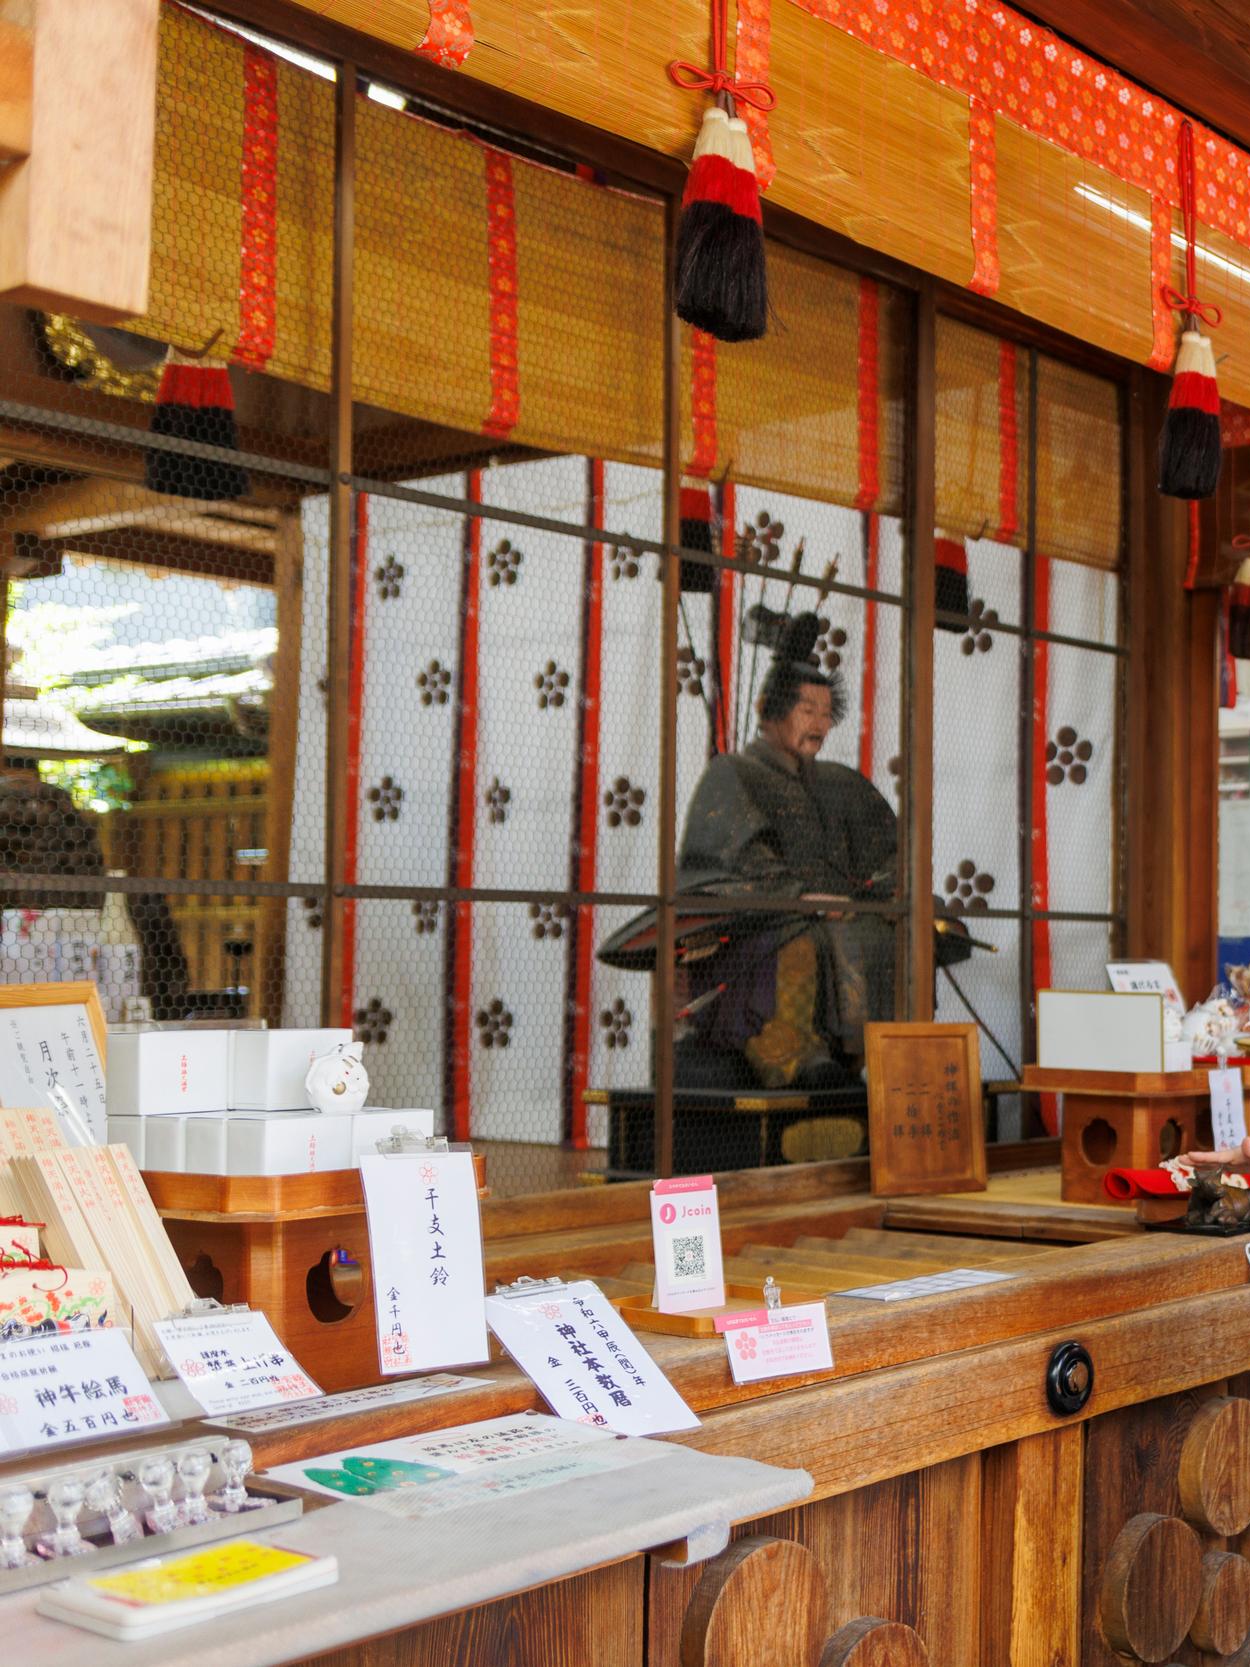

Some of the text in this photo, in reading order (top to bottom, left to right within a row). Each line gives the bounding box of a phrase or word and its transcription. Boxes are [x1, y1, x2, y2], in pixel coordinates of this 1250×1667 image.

[76, 1016, 107, 1104] 六月二十五日
[425, 1187, 450, 1287] 干支土鈴
[387, 1286, 406, 1356] 金千円也
[35, 1376, 128, 1408] 神牛絵馬
[547, 1356, 608, 1427] 金 三百円也
[556, 1322, 633, 1408] 神社本教暦
[40, 1408, 139, 1438] 金五百円也
